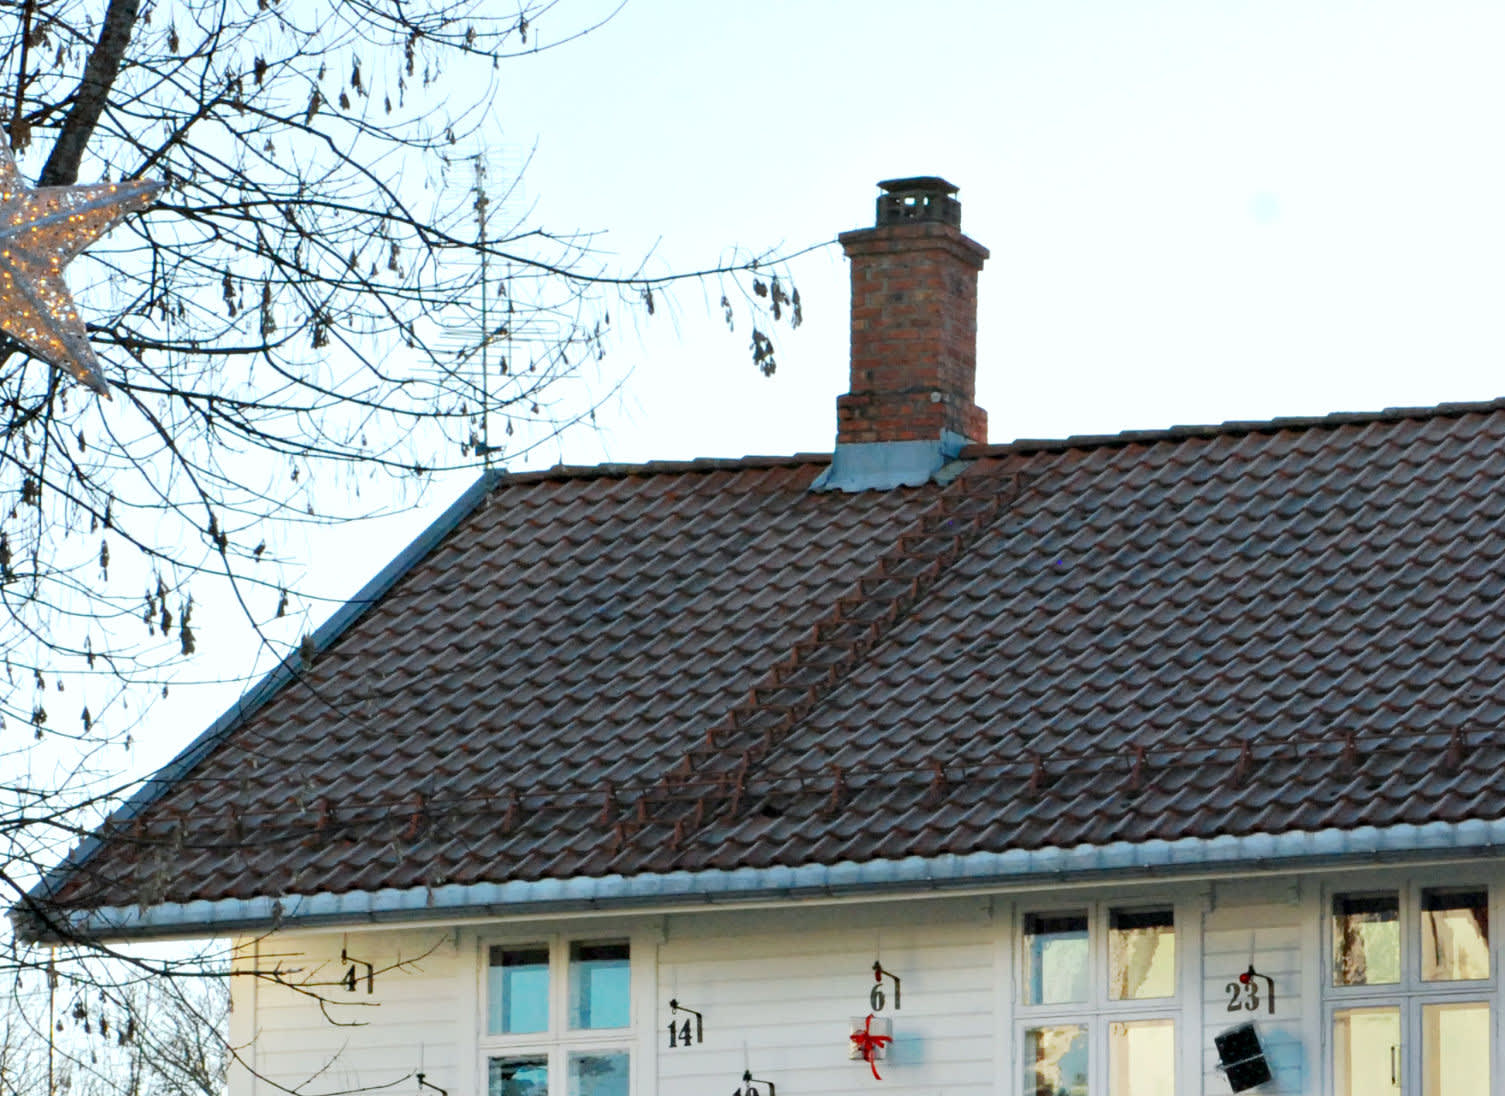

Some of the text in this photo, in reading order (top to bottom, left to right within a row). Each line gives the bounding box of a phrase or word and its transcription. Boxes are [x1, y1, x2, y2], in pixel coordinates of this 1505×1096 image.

[343, 964, 357, 991] 4
[870, 983, 886, 1012] 6
[1225, 982, 1261, 1012] 23
[667, 1018, 693, 1048] 14
